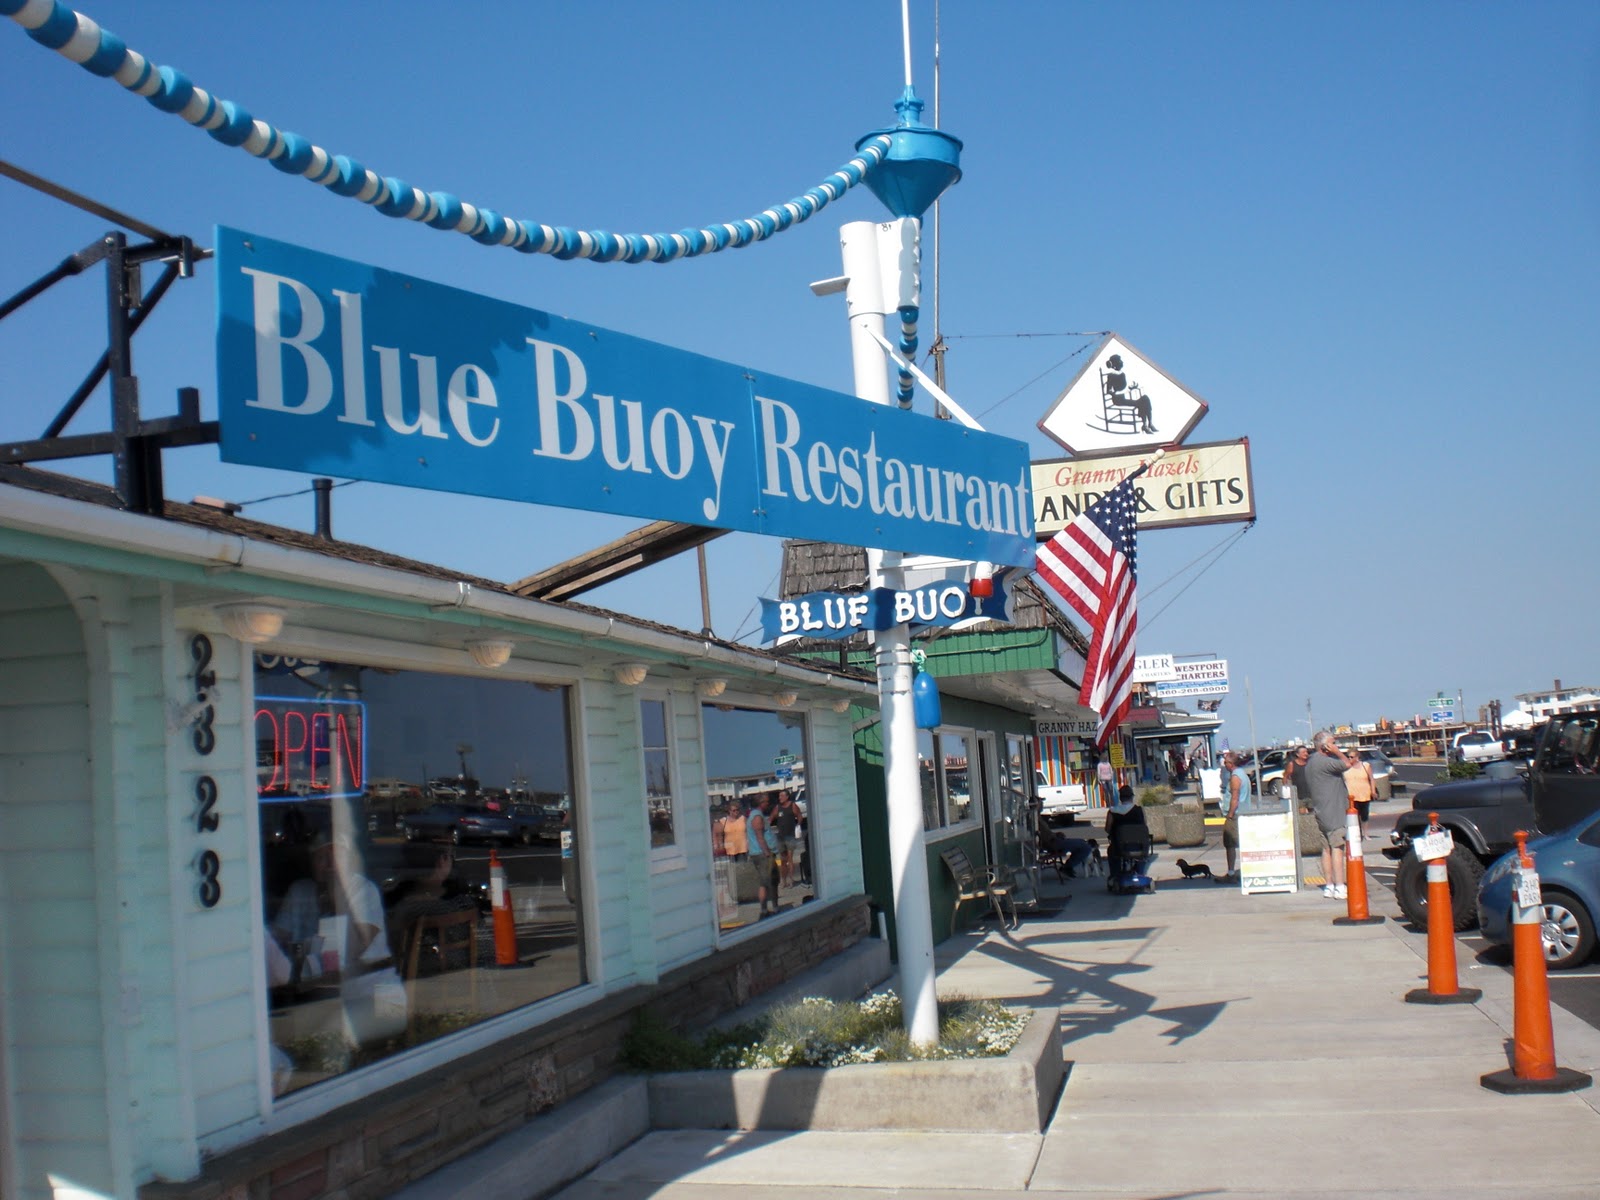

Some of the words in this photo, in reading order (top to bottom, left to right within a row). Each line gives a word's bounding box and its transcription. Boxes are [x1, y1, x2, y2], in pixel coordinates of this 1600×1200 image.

[240, 266, 500, 447] Blue
[526, 337, 735, 520] Buoy
[755, 395, 1032, 538] Restaurant
[1055, 466, 1126, 486] Granny
[1136, 454, 1200, 479] Hazels
[1033, 490, 1112, 523] AND
[1134, 486, 1158, 514] &
[1165, 477, 1244, 510] GIFTS
[779, 595, 869, 632] BLUE
[1174, 662, 1224, 673] WESTPORT
[1159, 685, 1228, 696] 360-268-0900
[1038, 721, 1075, 733] GRANNY
[253, 708, 361, 792] OPEN
